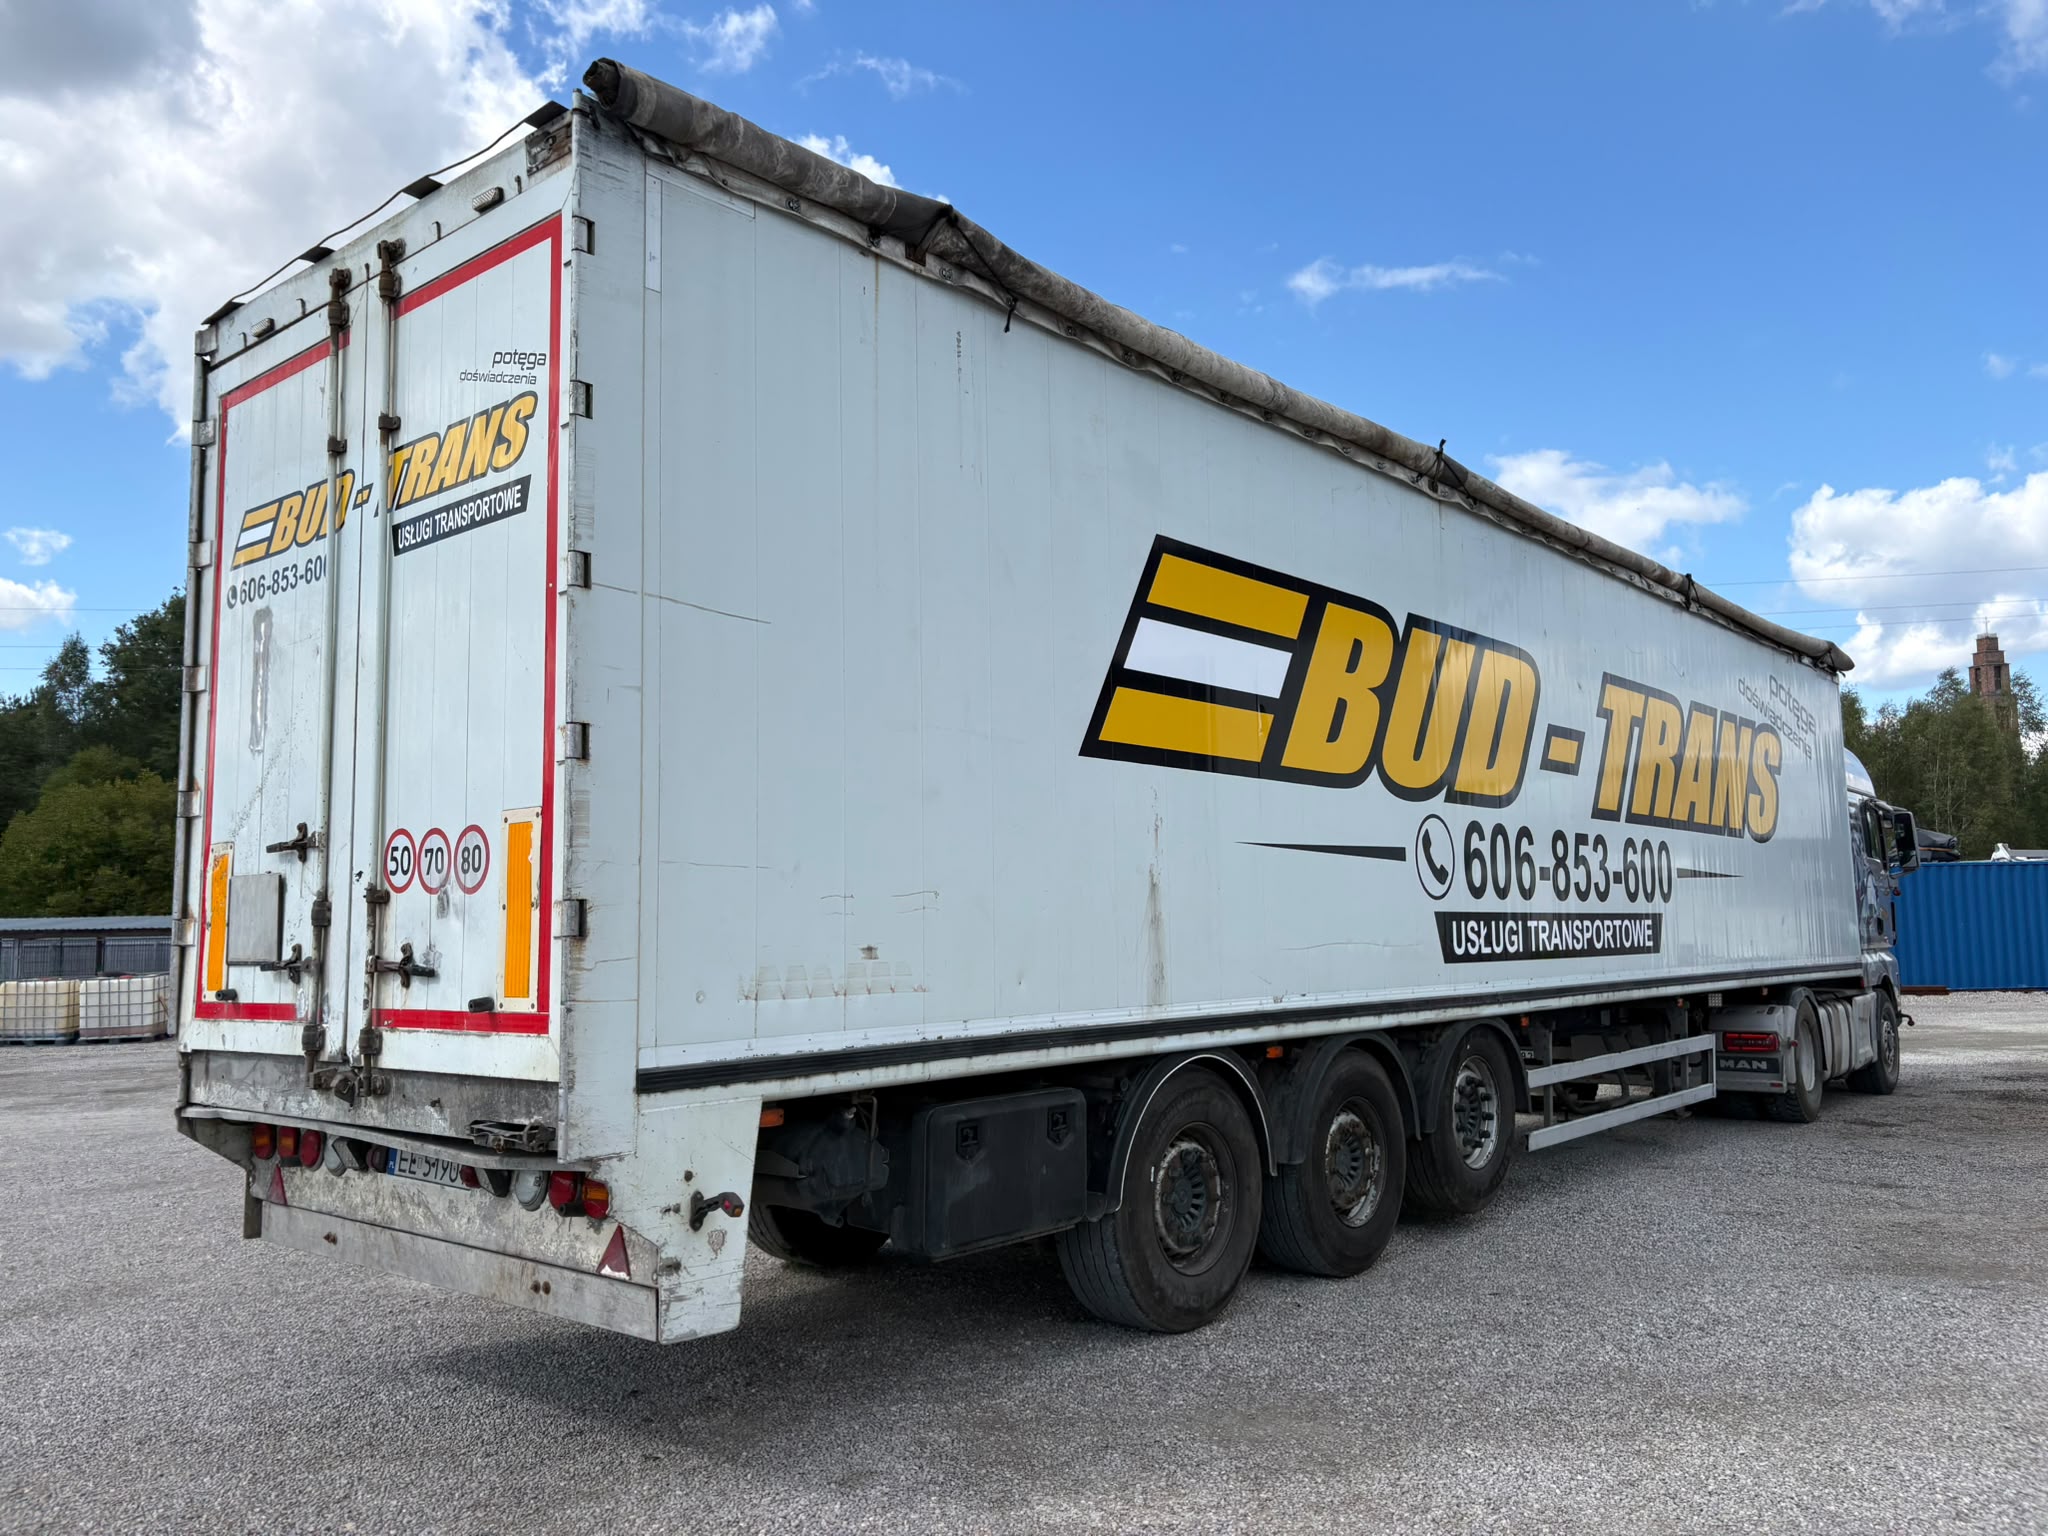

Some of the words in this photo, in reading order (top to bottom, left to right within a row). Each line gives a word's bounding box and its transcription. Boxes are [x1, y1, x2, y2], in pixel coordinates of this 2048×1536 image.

[492, 349, 547, 371] potęga
[459, 368, 537, 385] doświadczenia
[398, 518, 433, 549] USŁUGI
[434, 484, 522, 536] TRANSPORTOWE
[239, 554, 327, 605] 606-853-60
[1769, 674, 1816, 736] potęga
[389, 845, 411, 877] 50
[424, 846, 445, 876] 70
[461, 844, 482, 875] 80
[1463, 819, 1673, 904] 606-853-600
[1452, 919, 1523, 956] USŁUGI
[1527, 919, 1654, 952] TRANSPORTOWE
[1720, 1059, 1768, 1070] MAN
